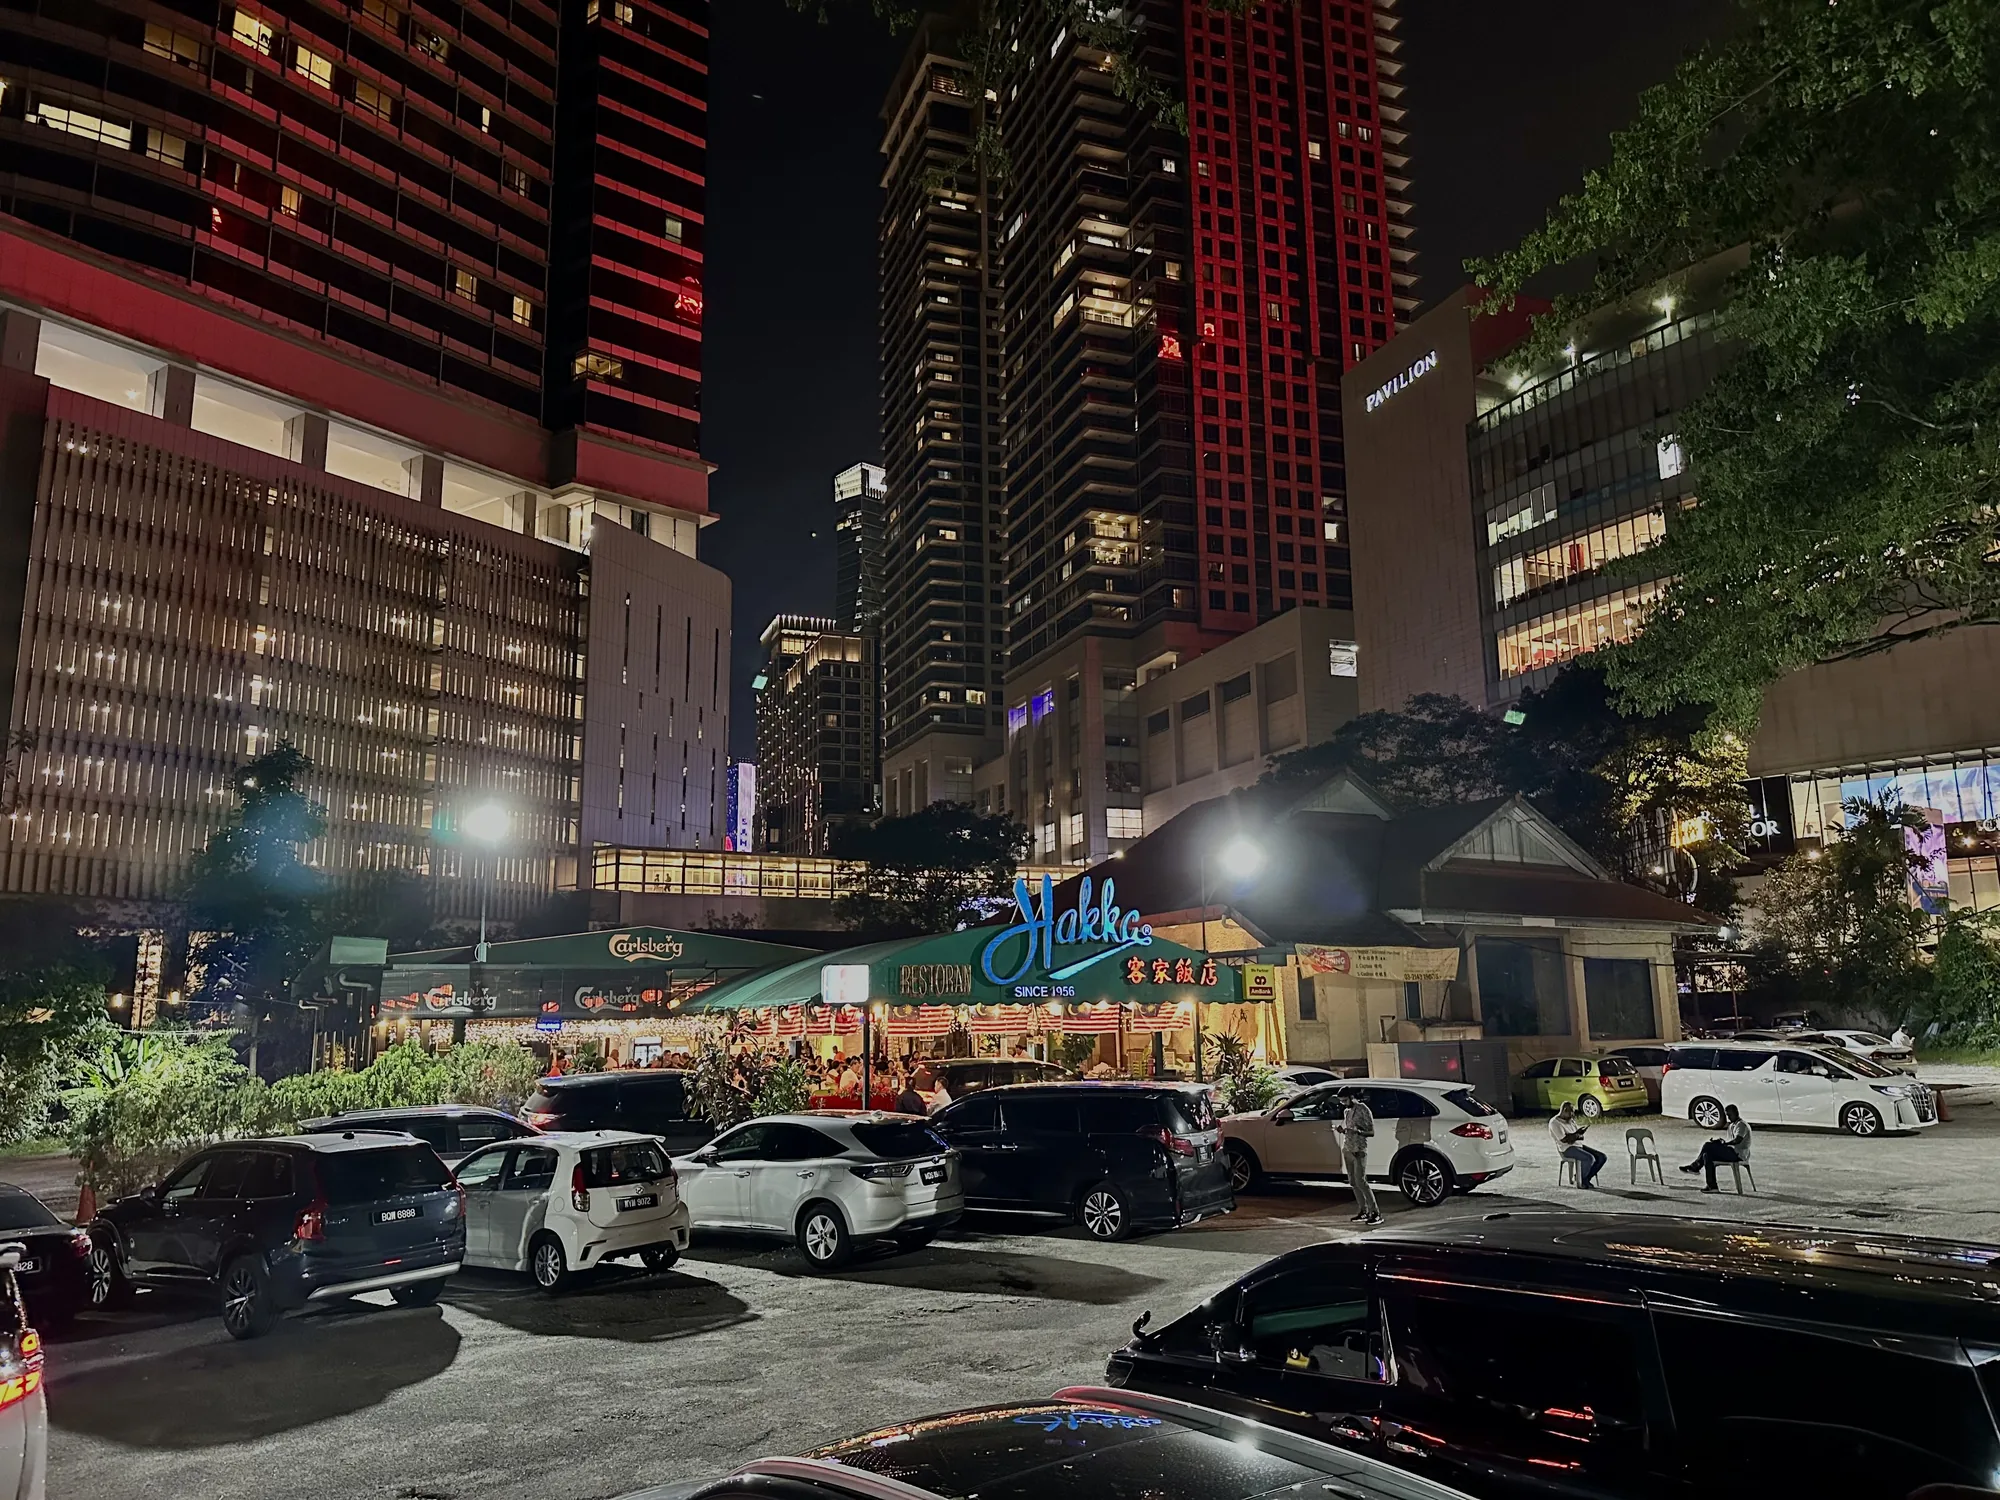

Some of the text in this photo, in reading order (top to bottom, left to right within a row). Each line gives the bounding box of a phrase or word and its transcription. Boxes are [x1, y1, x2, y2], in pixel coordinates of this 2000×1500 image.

[1366, 350, 1437, 412] PAVILION
[981, 872, 1153, 985] Hakka
[608, 933, 684, 962] Carlsberg
[901, 964, 972, 995] RESTORAN
[1126, 957, 1219, 986] 客家飯店
[425, 984, 498, 1013] Crlsberg
[1014, 985, 1075, 998] SINCE 1956
